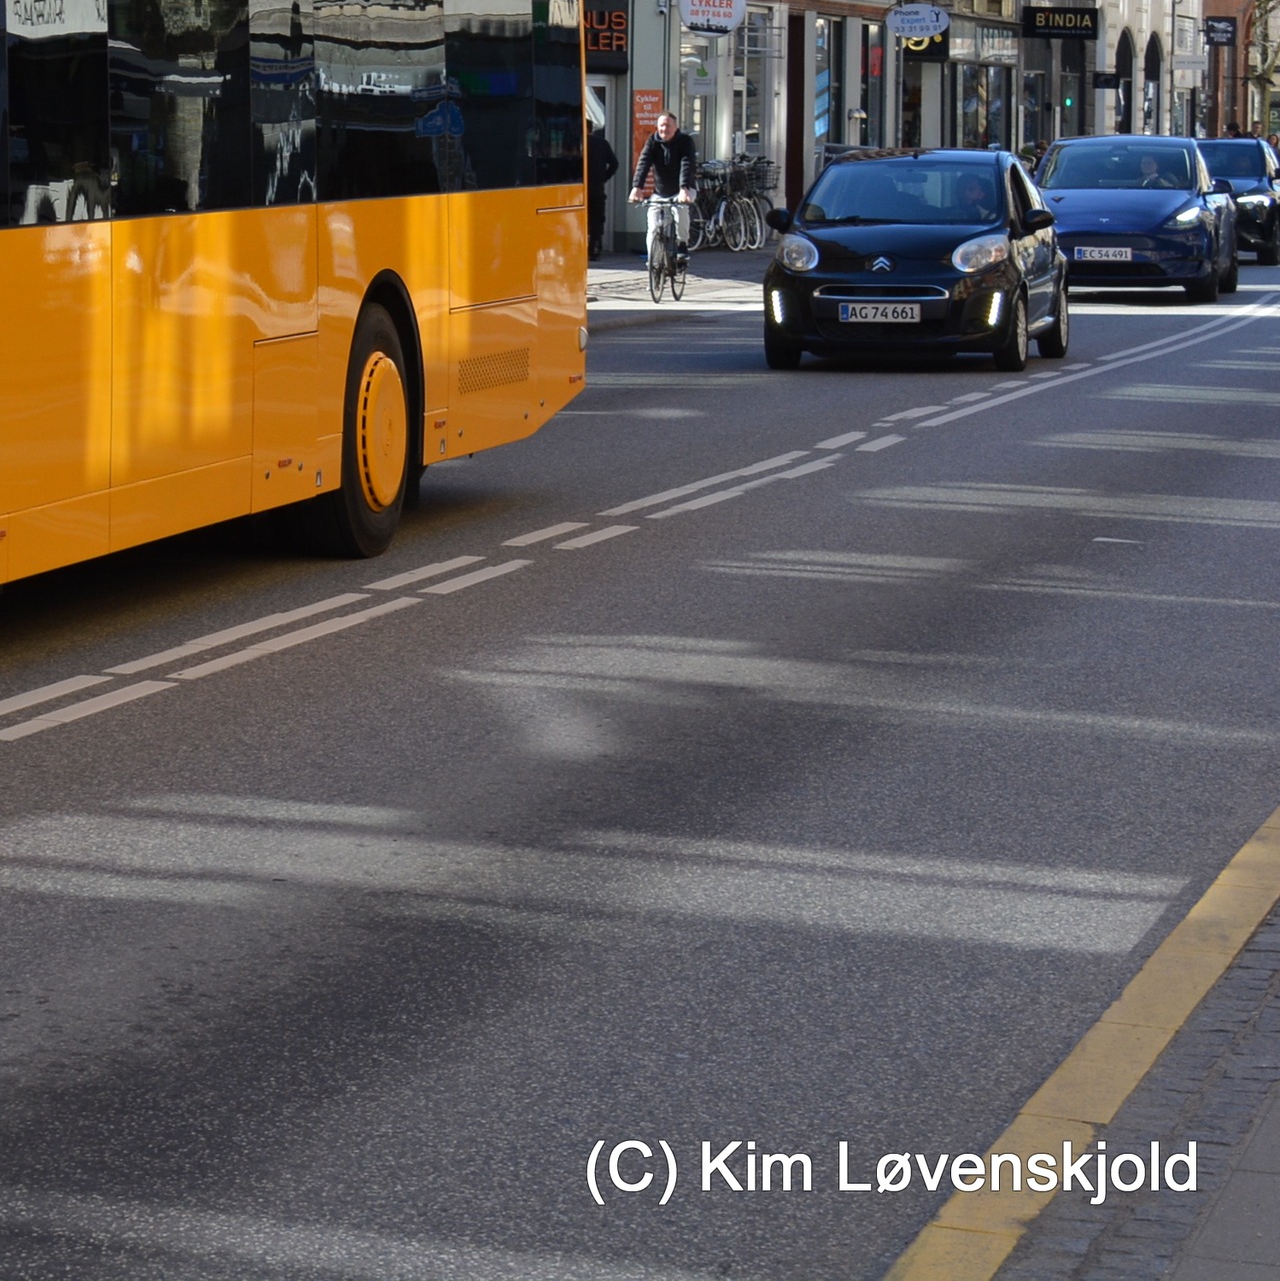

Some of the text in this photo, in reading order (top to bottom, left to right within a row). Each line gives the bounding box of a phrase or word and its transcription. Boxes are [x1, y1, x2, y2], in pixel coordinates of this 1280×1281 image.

[894, 9, 919, 17] Phone
[587, 32, 627, 52] LER
[636, 95, 659, 103] Cykler
[1083, 250, 1128, 259] EC 54 491
[849, 306, 916, 319] AG 74 661
